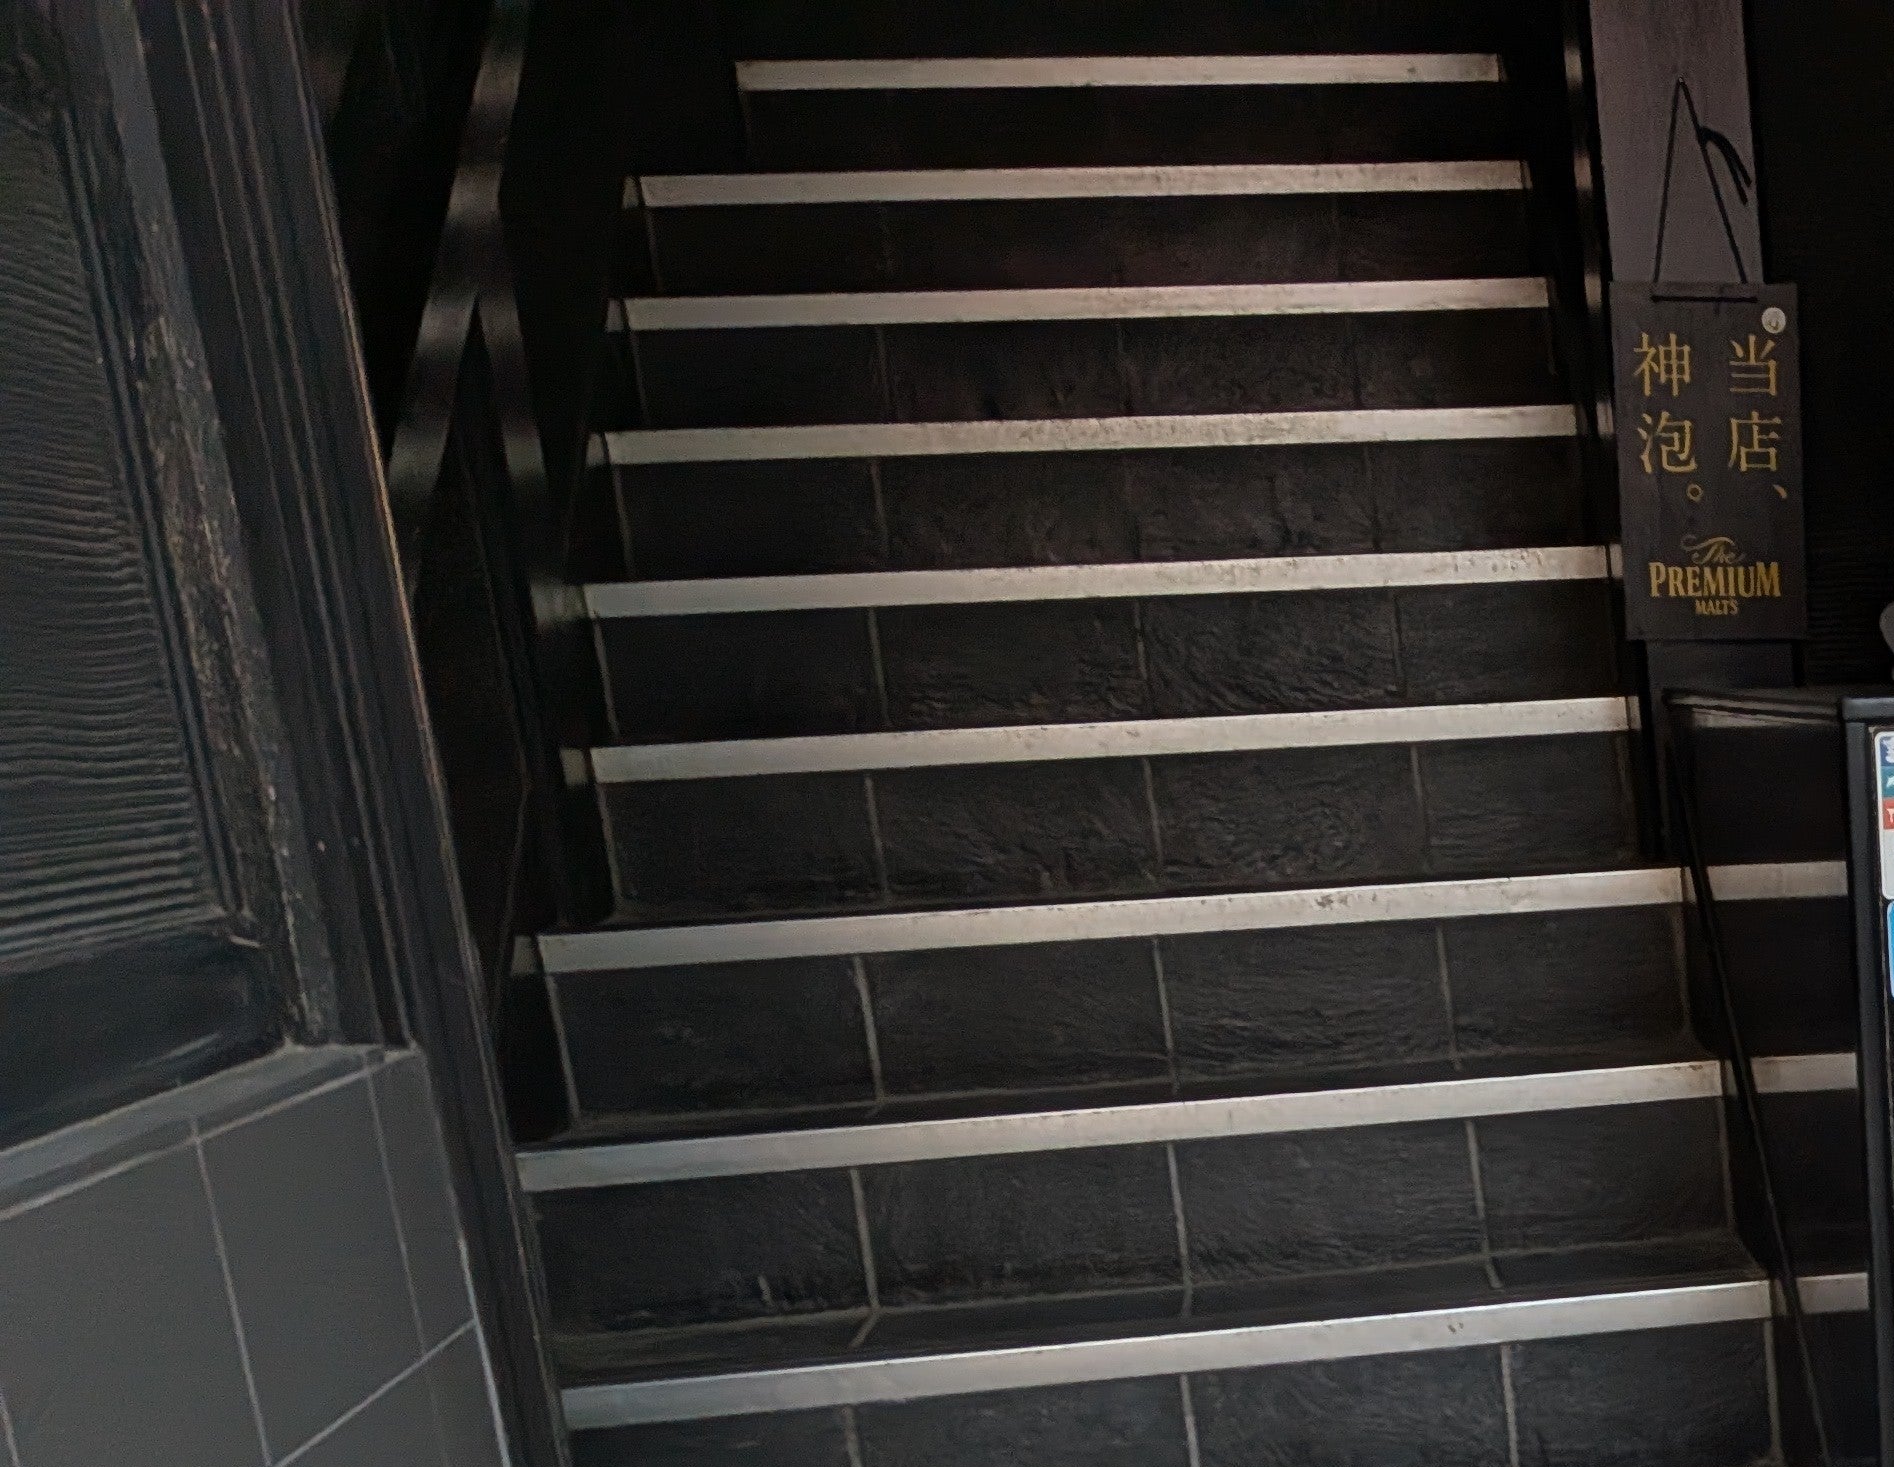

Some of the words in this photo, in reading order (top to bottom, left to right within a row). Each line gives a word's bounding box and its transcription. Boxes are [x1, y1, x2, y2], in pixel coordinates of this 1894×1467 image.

[1632, 330, 1704, 502] 神泡。
[1727, 333, 1789, 499] 当店、
[1648, 561, 1782, 598] PREMIUM
[1680, 534, 1747, 565] The
